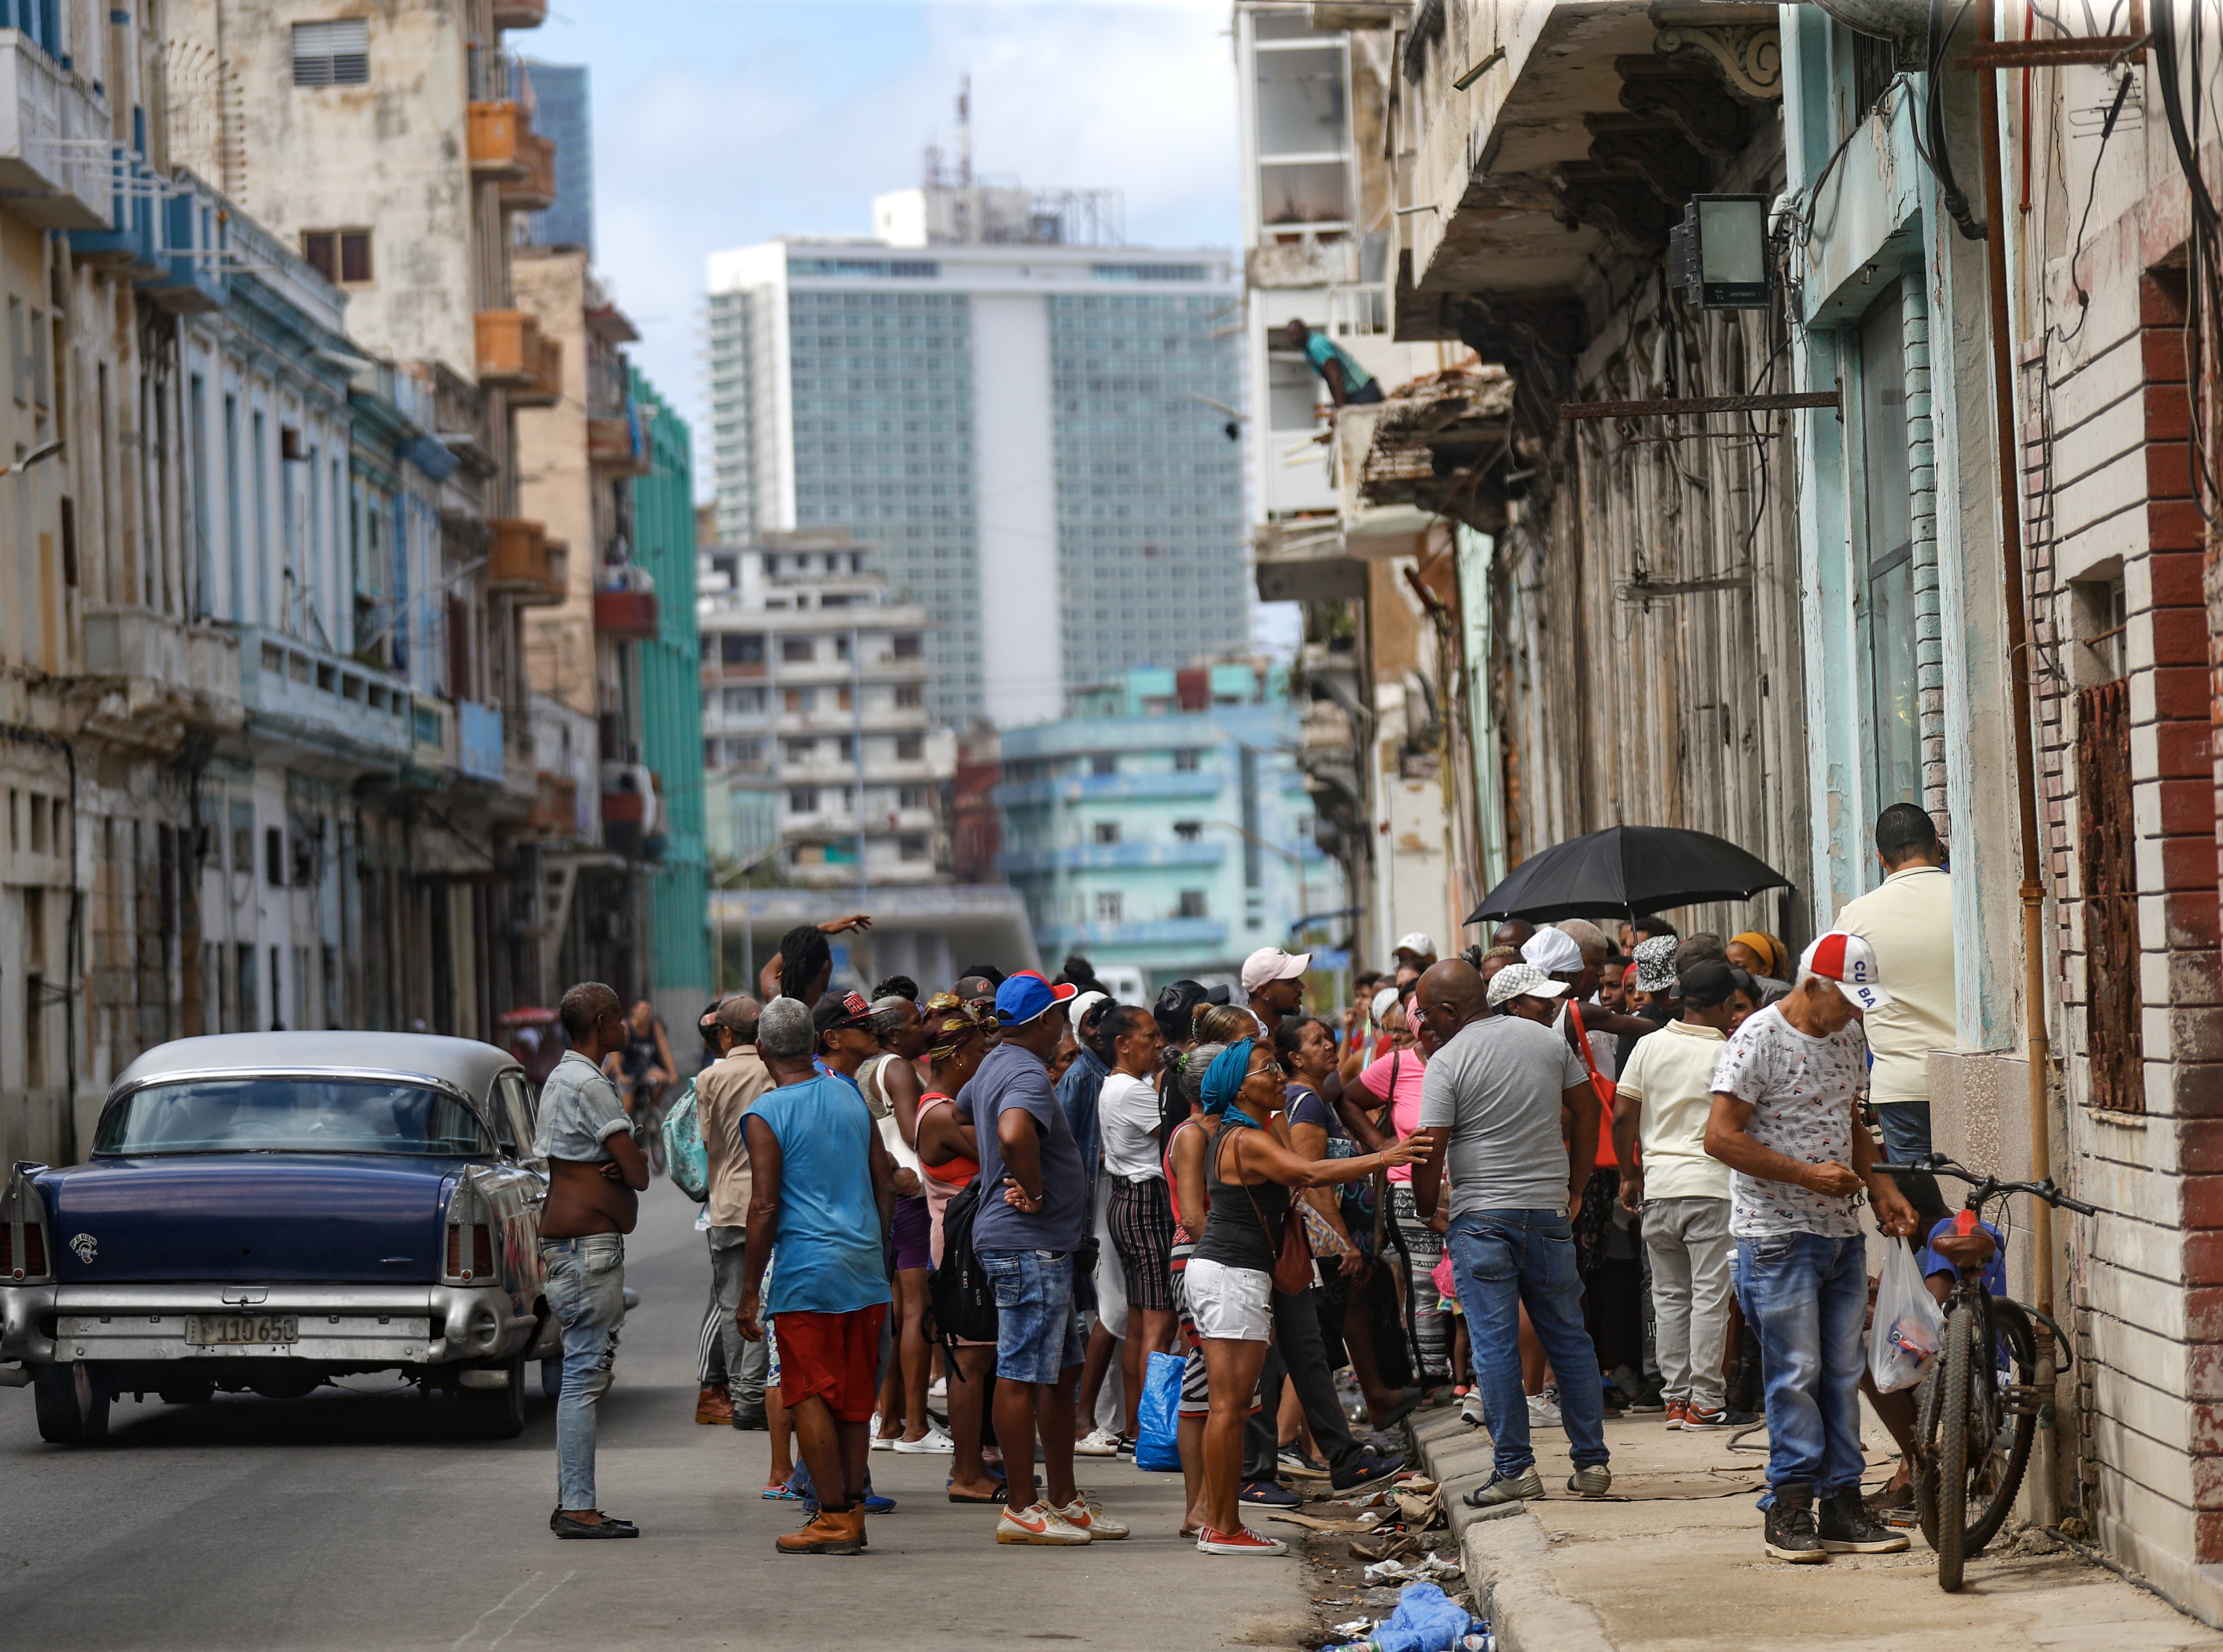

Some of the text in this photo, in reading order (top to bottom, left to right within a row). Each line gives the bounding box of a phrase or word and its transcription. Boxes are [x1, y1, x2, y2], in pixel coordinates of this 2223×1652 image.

[1854, 960, 1876, 1008] CUBA
[1774, 1207, 1793, 1219] FILA
[1834, 1208, 1848, 1217] FILA
